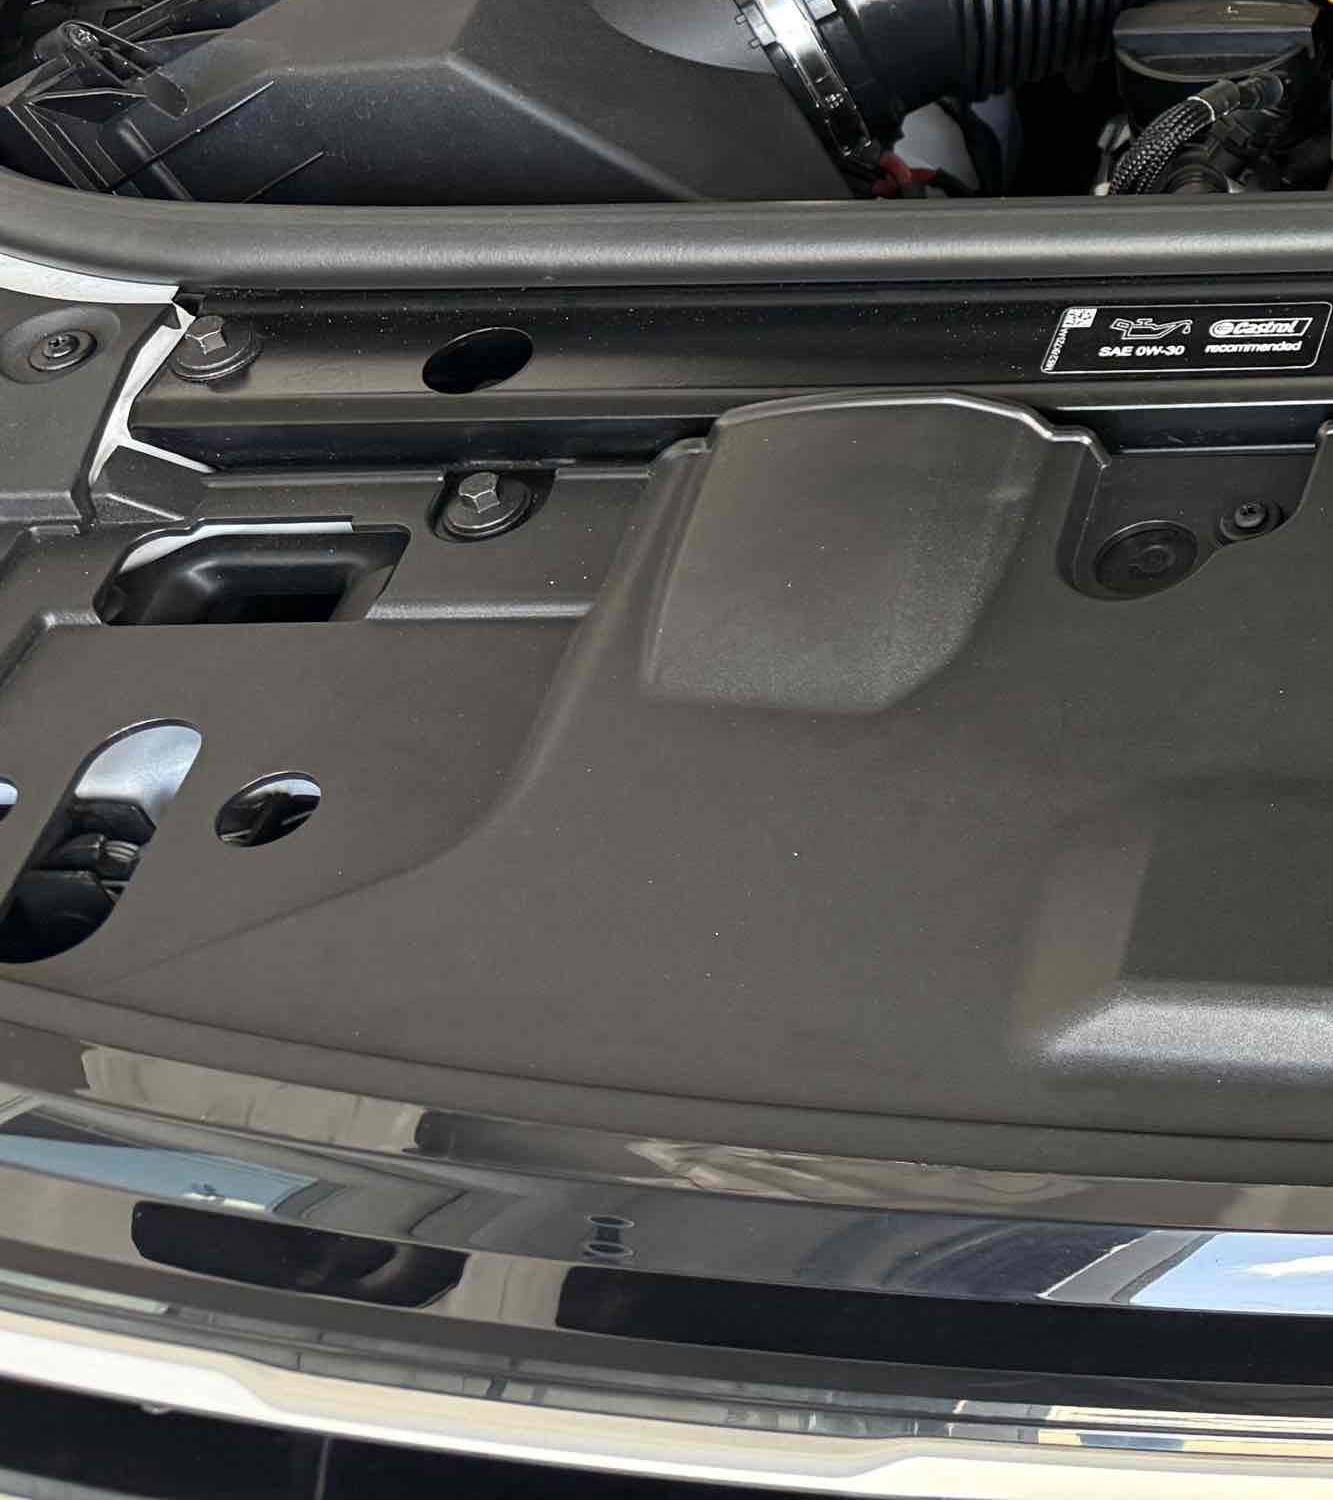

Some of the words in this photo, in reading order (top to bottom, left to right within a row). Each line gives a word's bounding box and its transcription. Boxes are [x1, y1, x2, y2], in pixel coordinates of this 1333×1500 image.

[1232, 319, 1299, 335] Castrol
[1098, 345, 1134, 357] SAE
[1134, 344, 1186, 356] 0W-30
[1204, 340, 1303, 353] recommended
